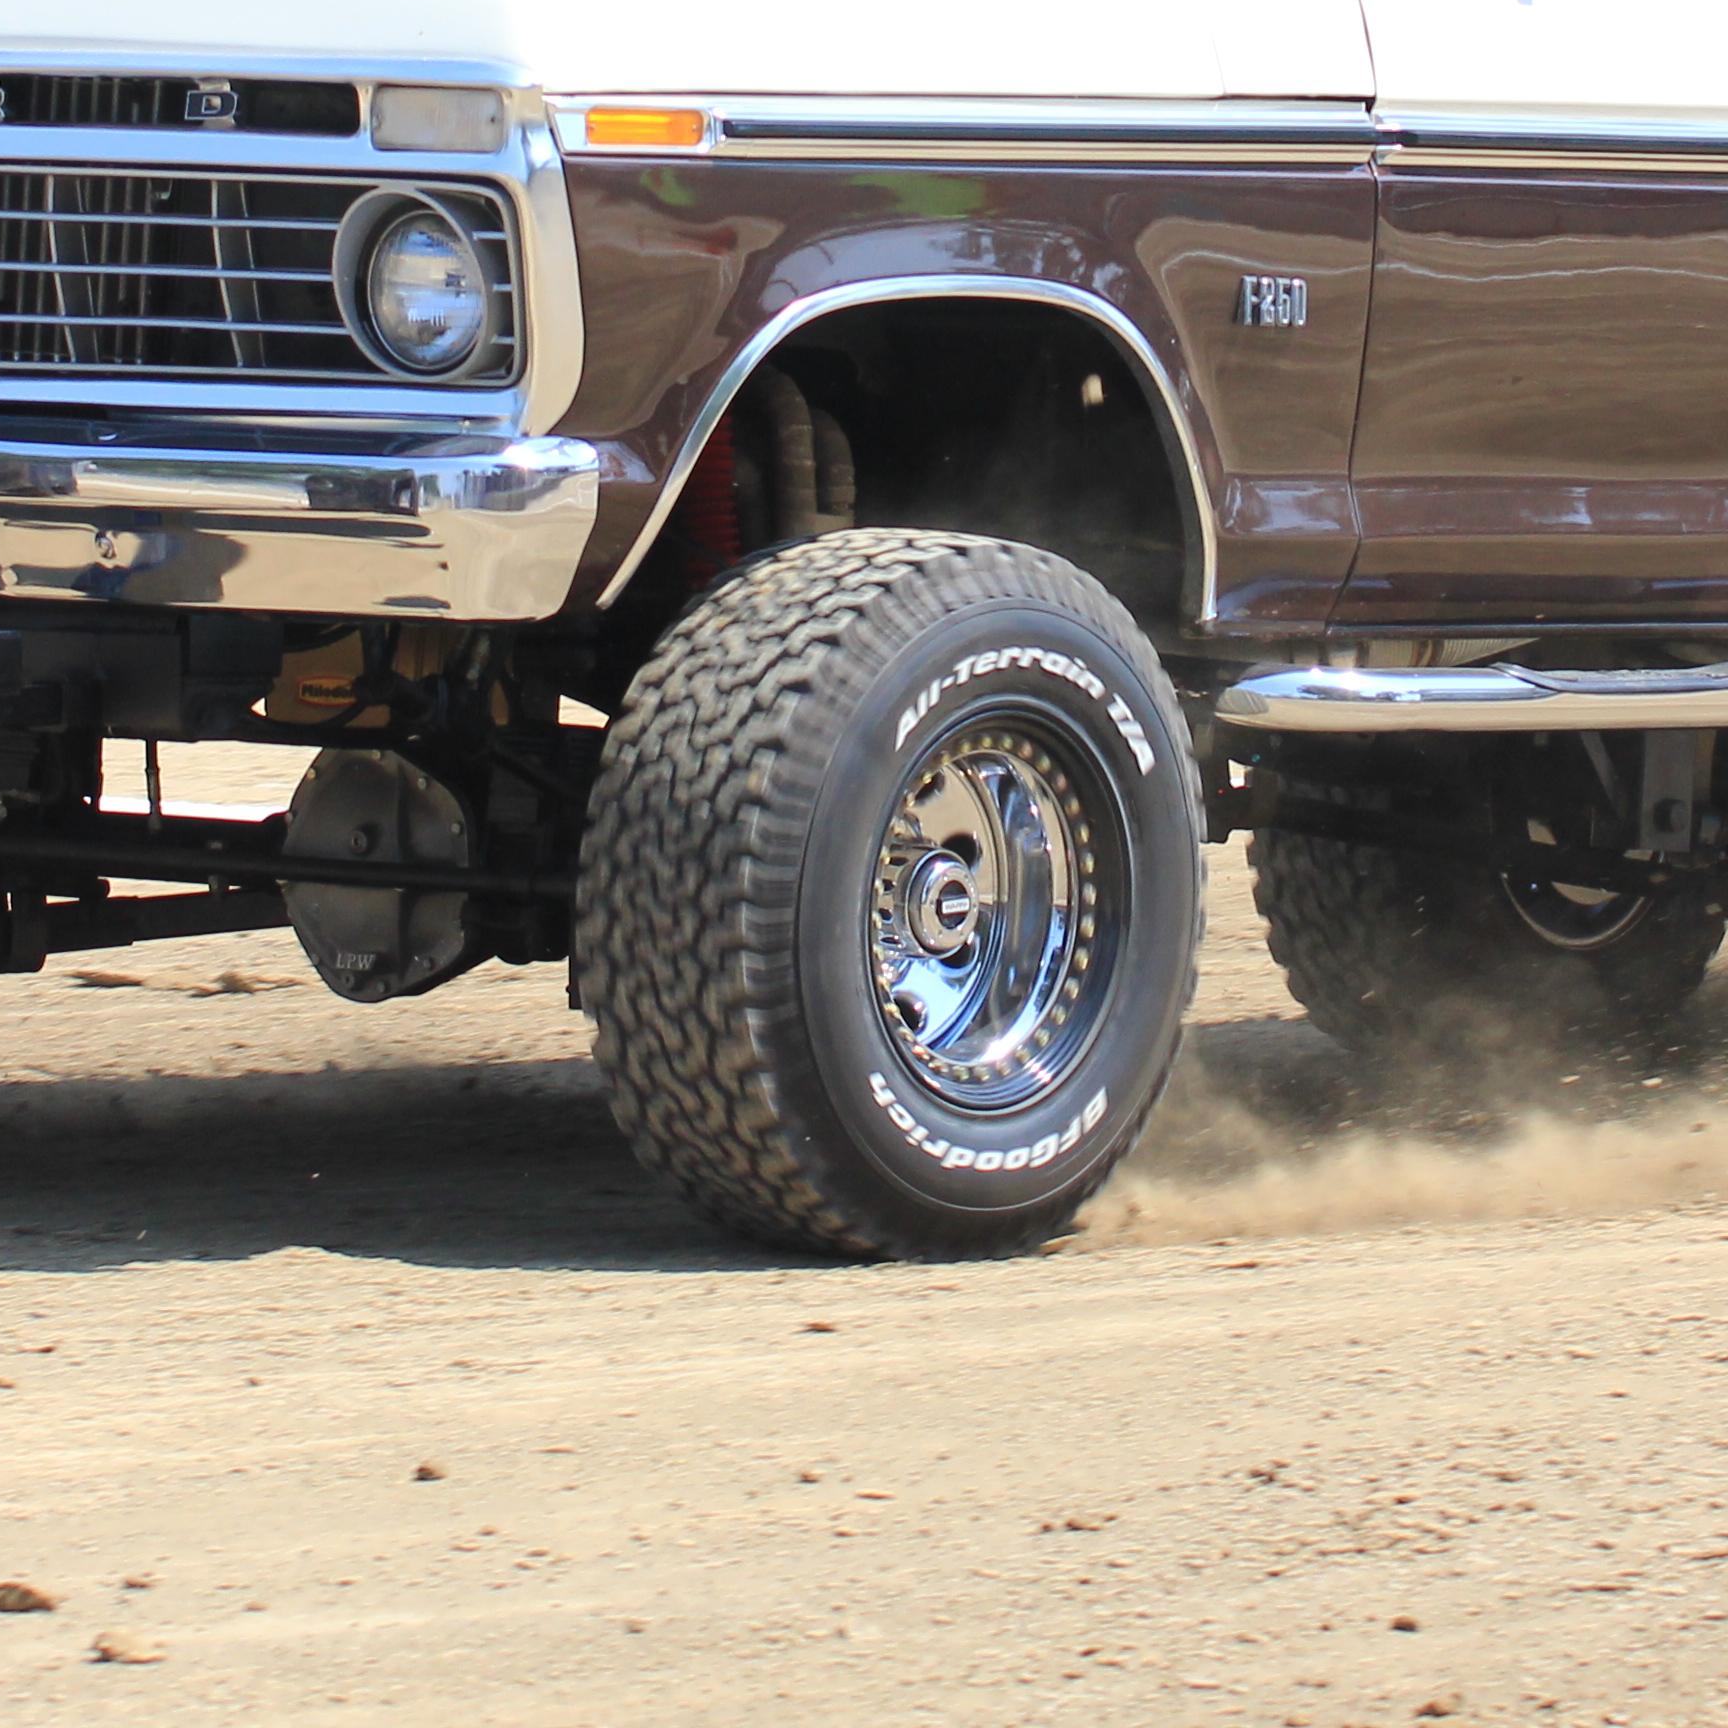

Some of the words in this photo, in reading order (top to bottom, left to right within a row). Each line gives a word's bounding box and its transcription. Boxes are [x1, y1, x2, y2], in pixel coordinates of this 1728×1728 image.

[1239, 274, 1308, 327] F250
[894, 645, 1106, 753] All-Terrain
[335, 953, 377, 970] LPW
[867, 1071, 1109, 1172] BFGoodrich
